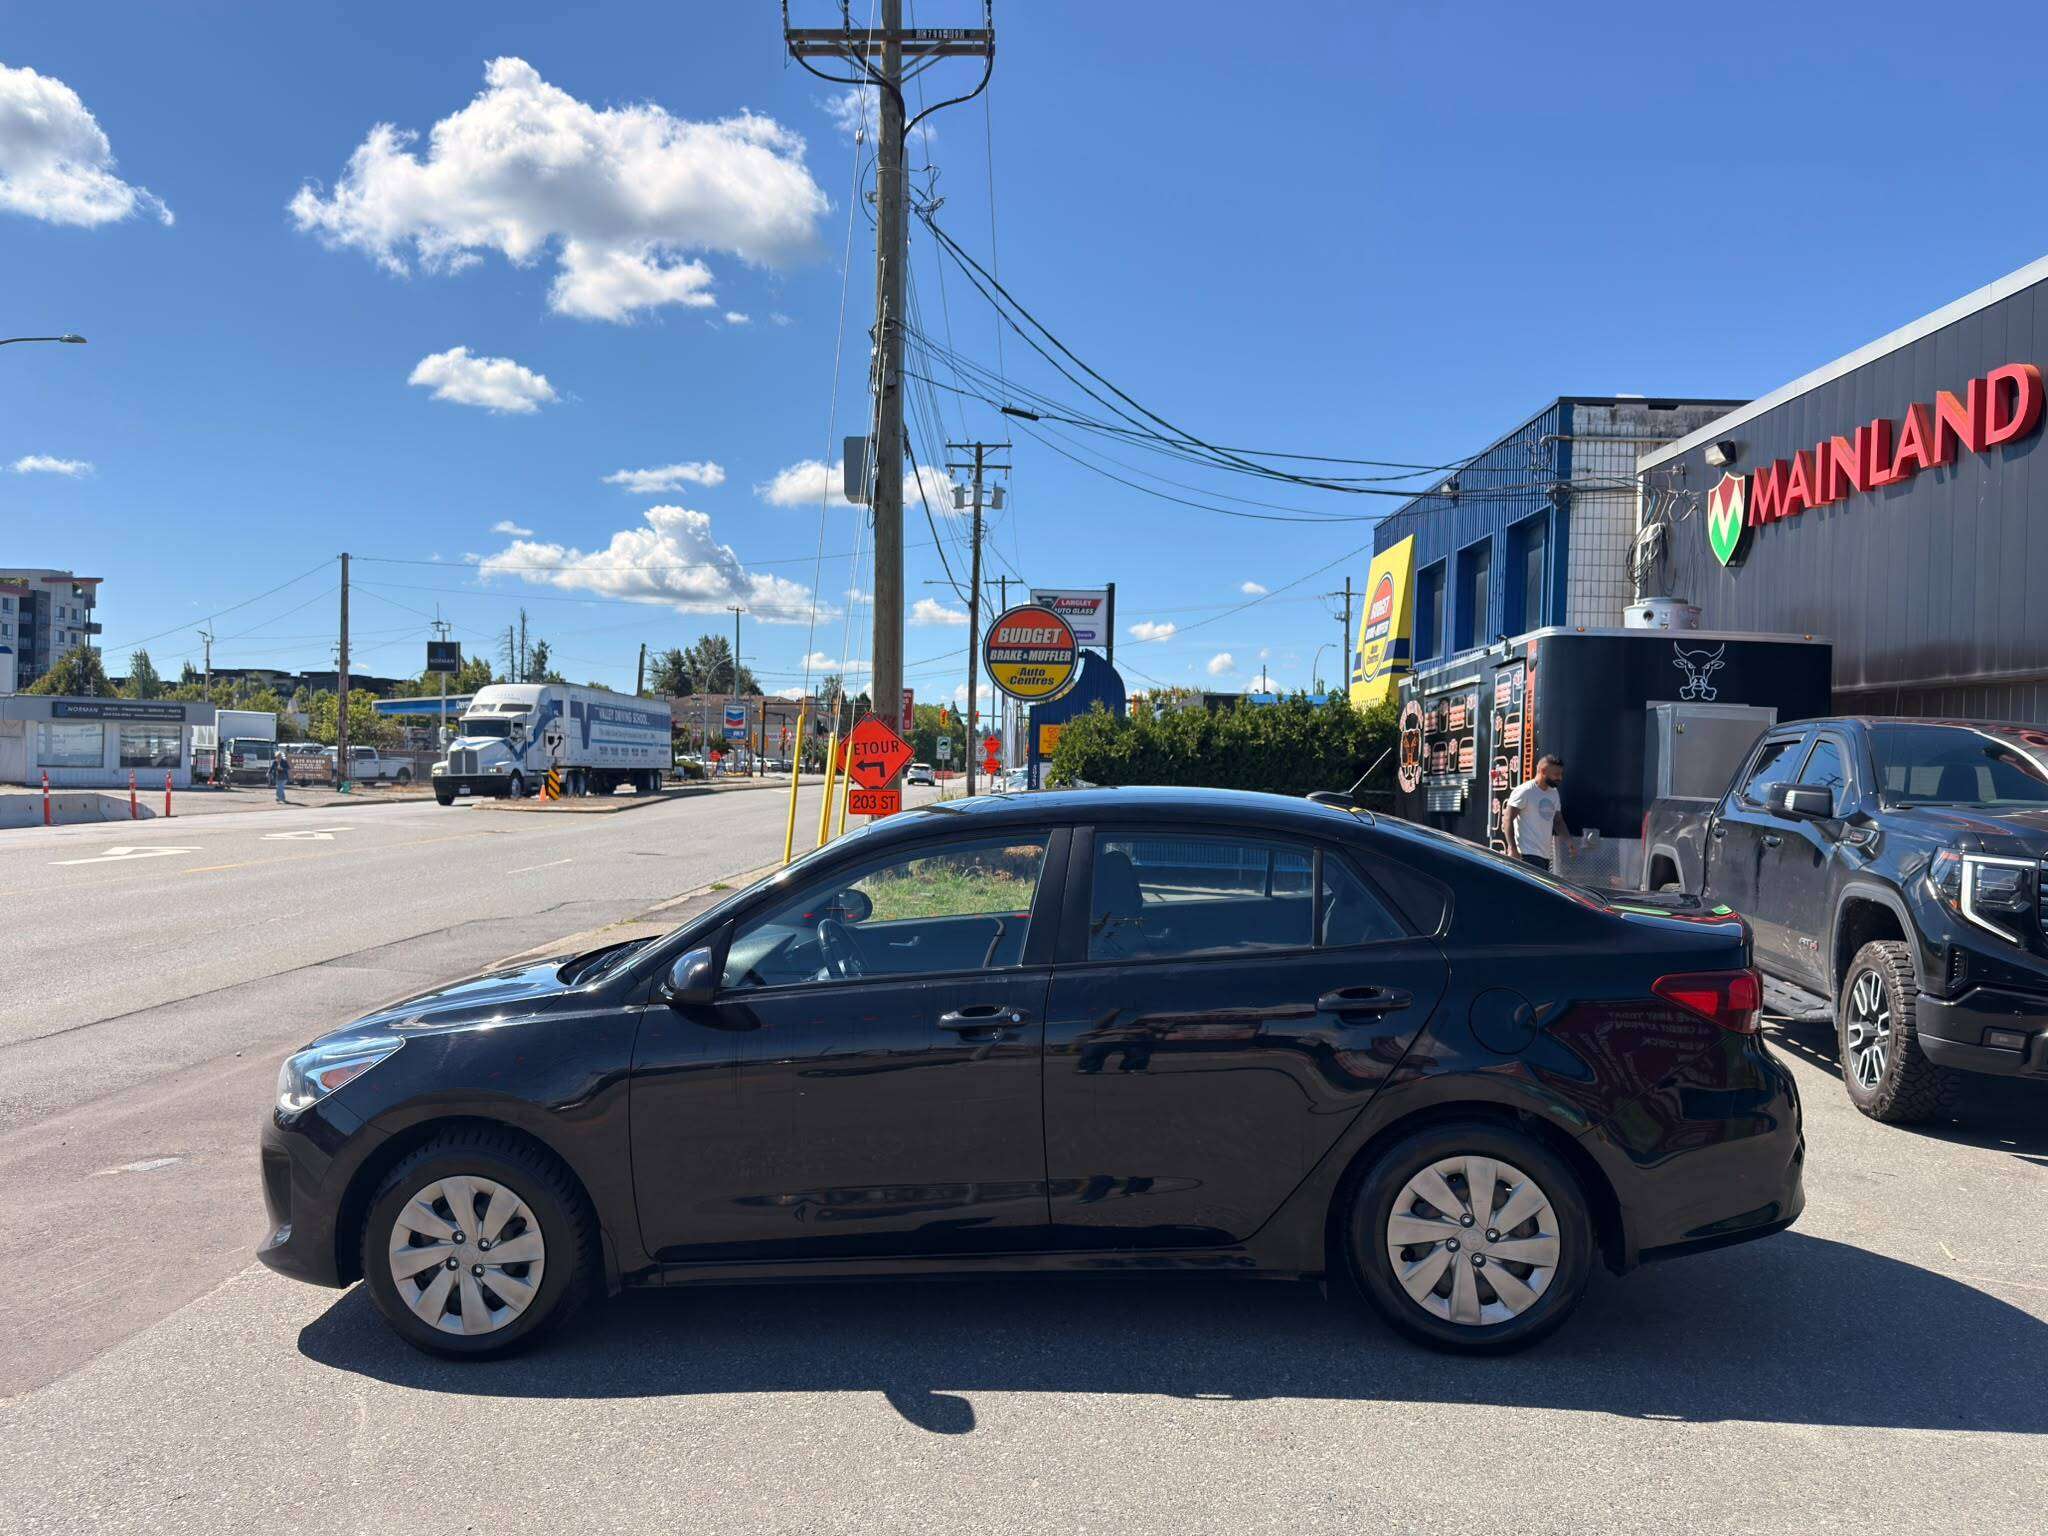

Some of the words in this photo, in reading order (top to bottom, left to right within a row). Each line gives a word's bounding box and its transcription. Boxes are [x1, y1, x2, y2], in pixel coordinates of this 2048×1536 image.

[1748, 363, 2045, 527] MAINLAND
[1061, 599, 1092, 607] LANGLEY
[998, 627, 1062, 644] BUDGET
[990, 649, 1023, 661] BRAKE
[1028, 650, 1072, 662] MUFFLER
[1019, 667, 1046, 677] Auto
[1009, 675, 1055, 686] Centres
[853, 795, 877, 809] 203
[881, 795, 896, 809] ST
